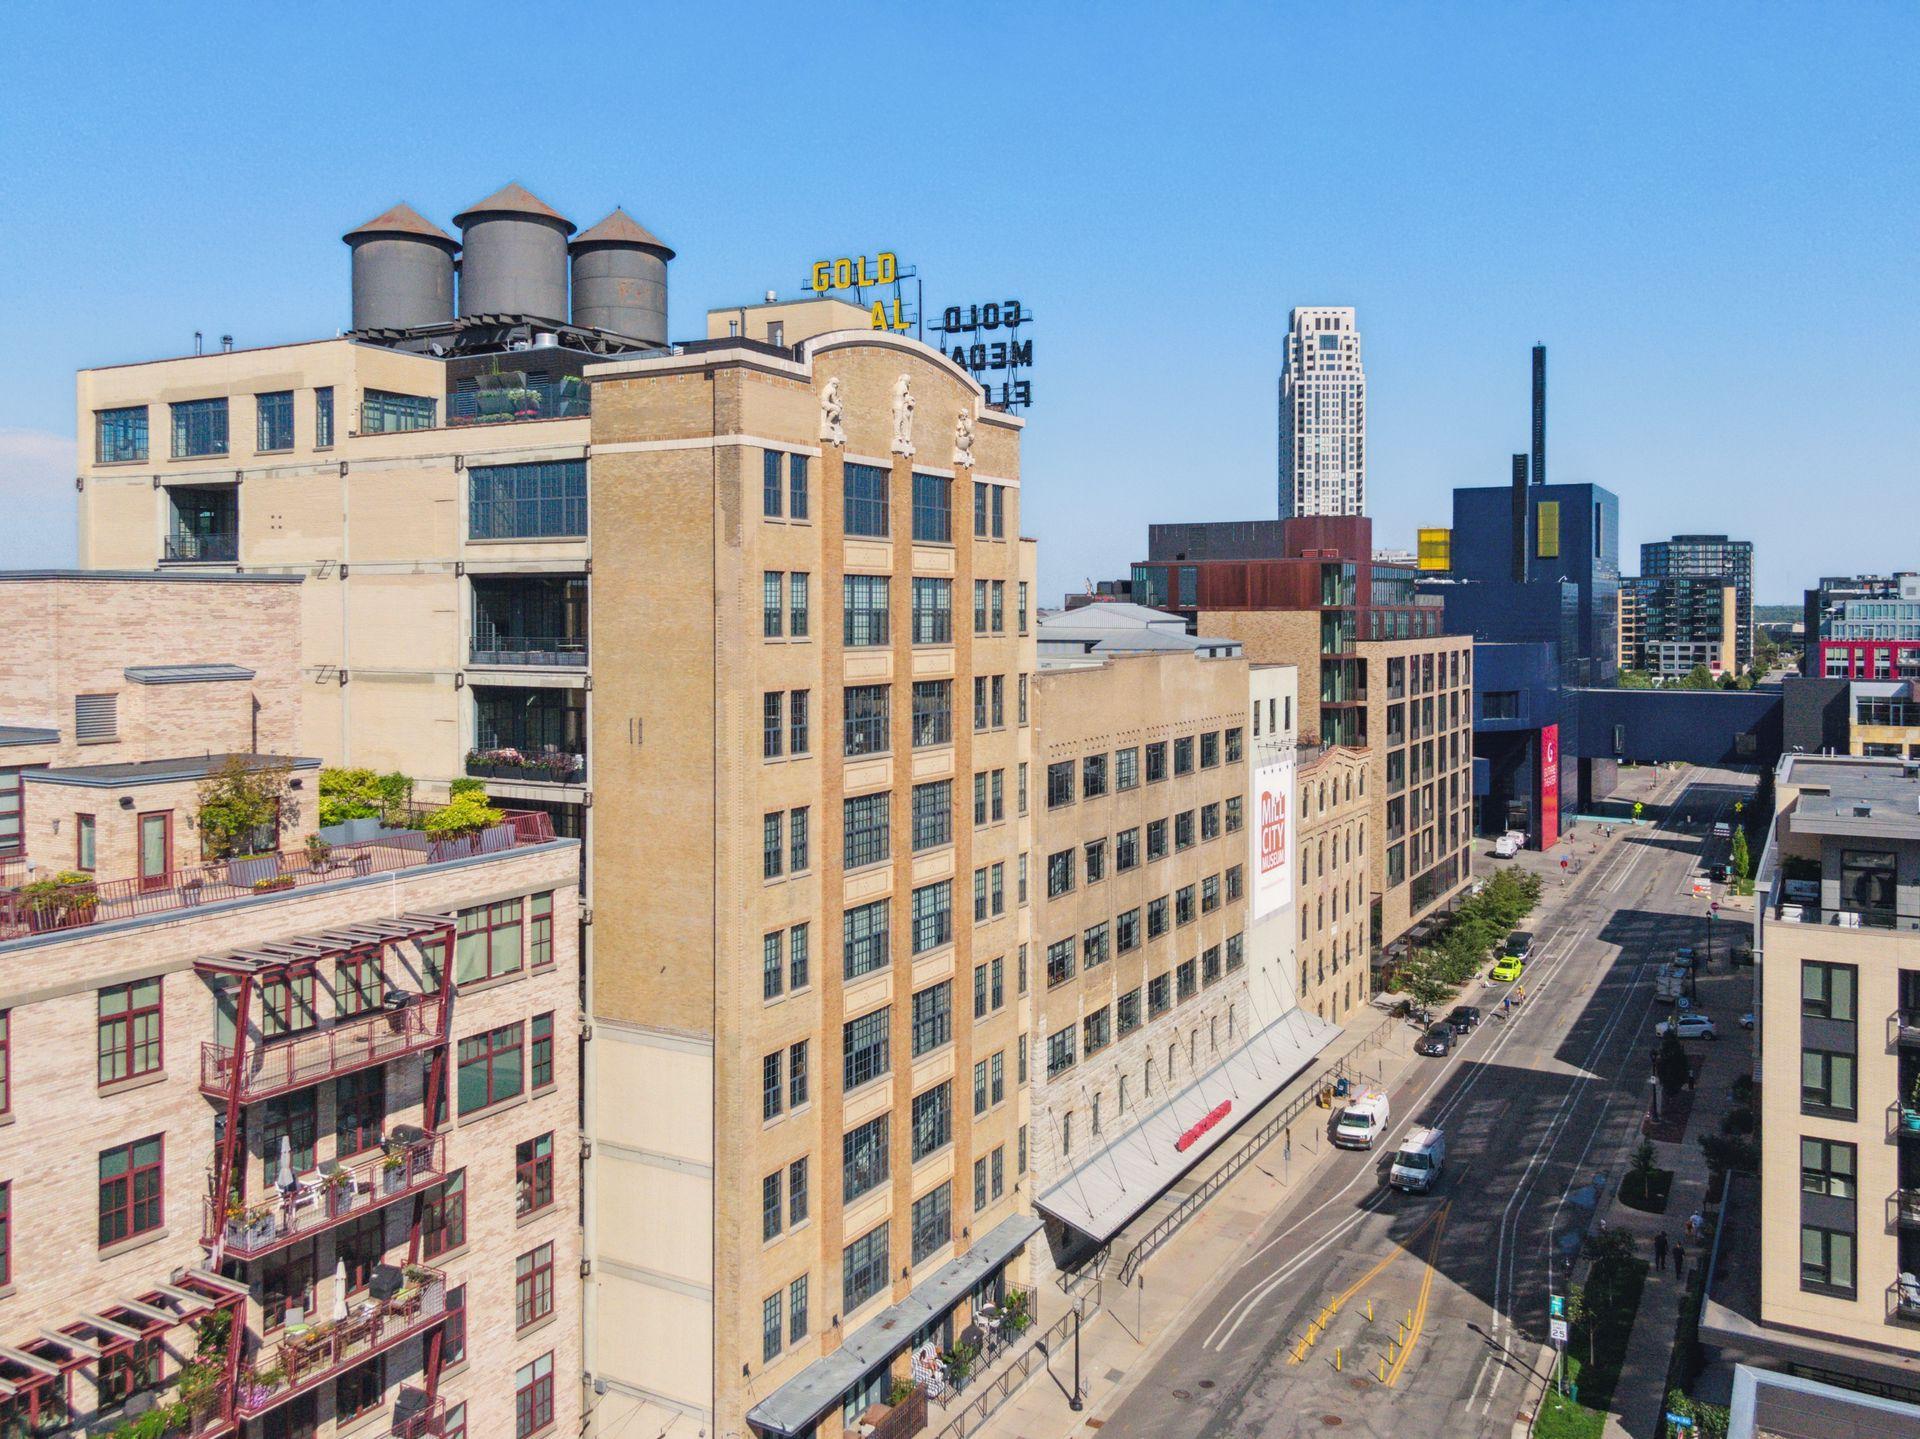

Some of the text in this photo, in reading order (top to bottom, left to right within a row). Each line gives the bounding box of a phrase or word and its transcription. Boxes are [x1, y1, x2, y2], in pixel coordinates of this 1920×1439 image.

[812, 252, 896, 291] GOLD
[1262, 822, 1285, 854] CITY
[1261, 849, 1285, 869] MUSEUM
[1552, 1329, 1565, 1339] 25
